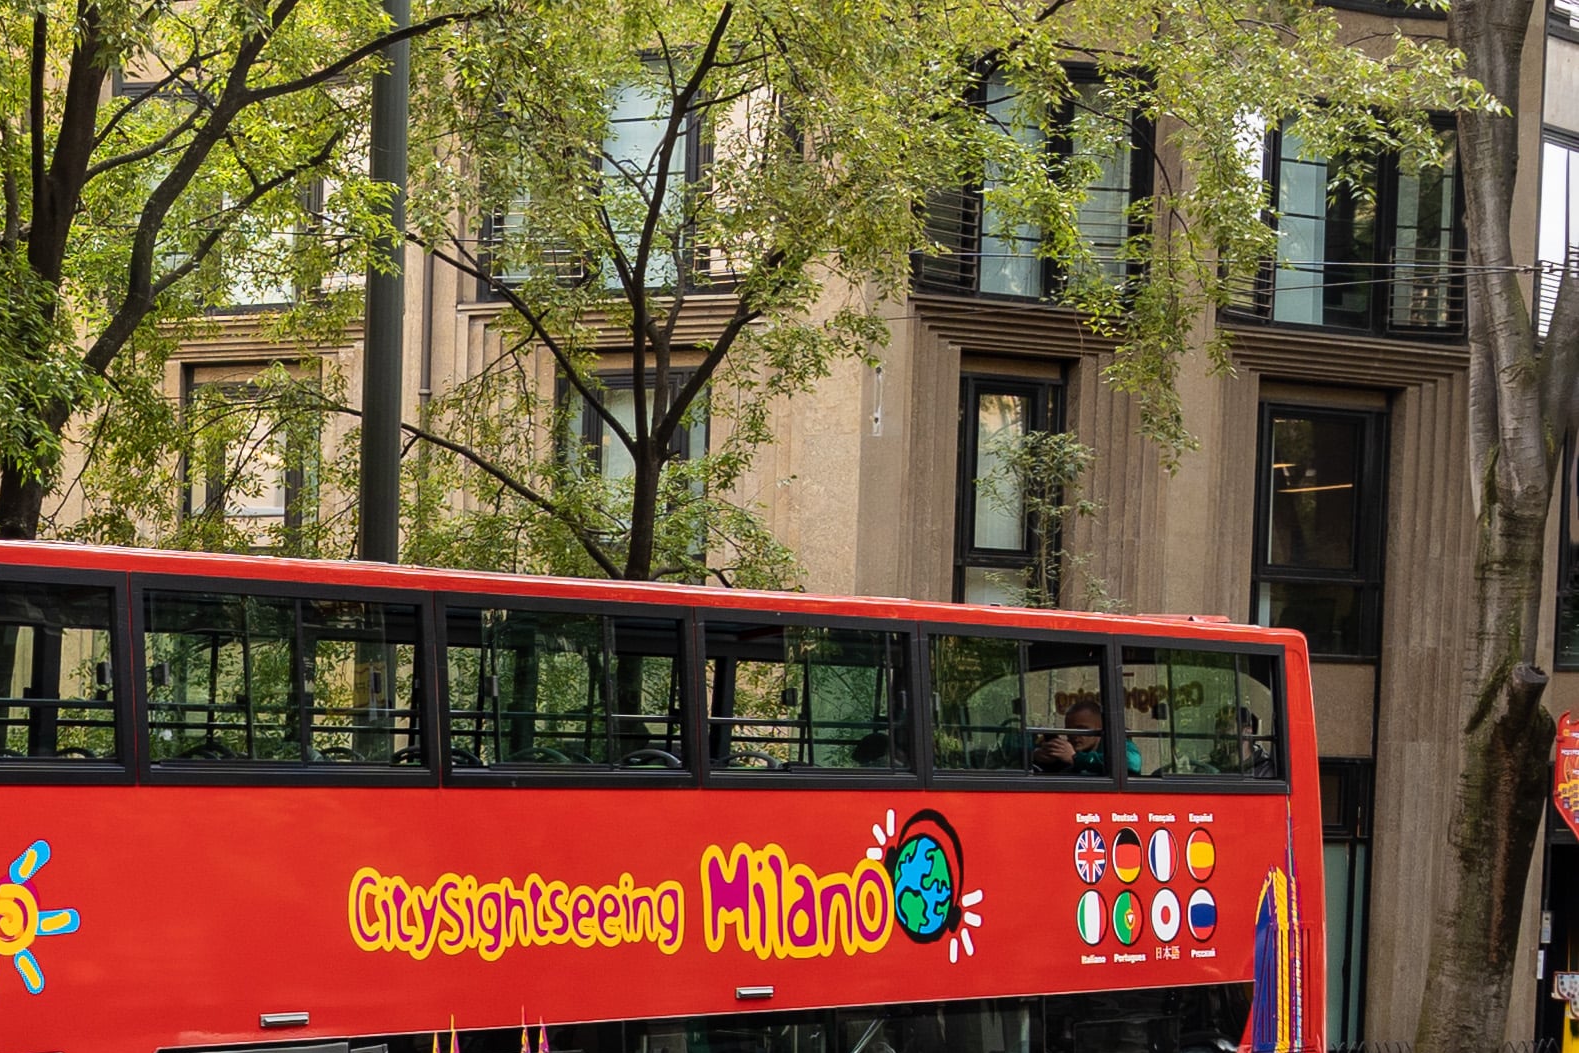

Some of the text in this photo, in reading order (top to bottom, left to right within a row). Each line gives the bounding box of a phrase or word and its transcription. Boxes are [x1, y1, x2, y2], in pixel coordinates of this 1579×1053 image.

[1076, 813, 1101, 825] English
[1112, 812, 1139, 822] Deutsch
[701, 842, 895, 960] Milano
